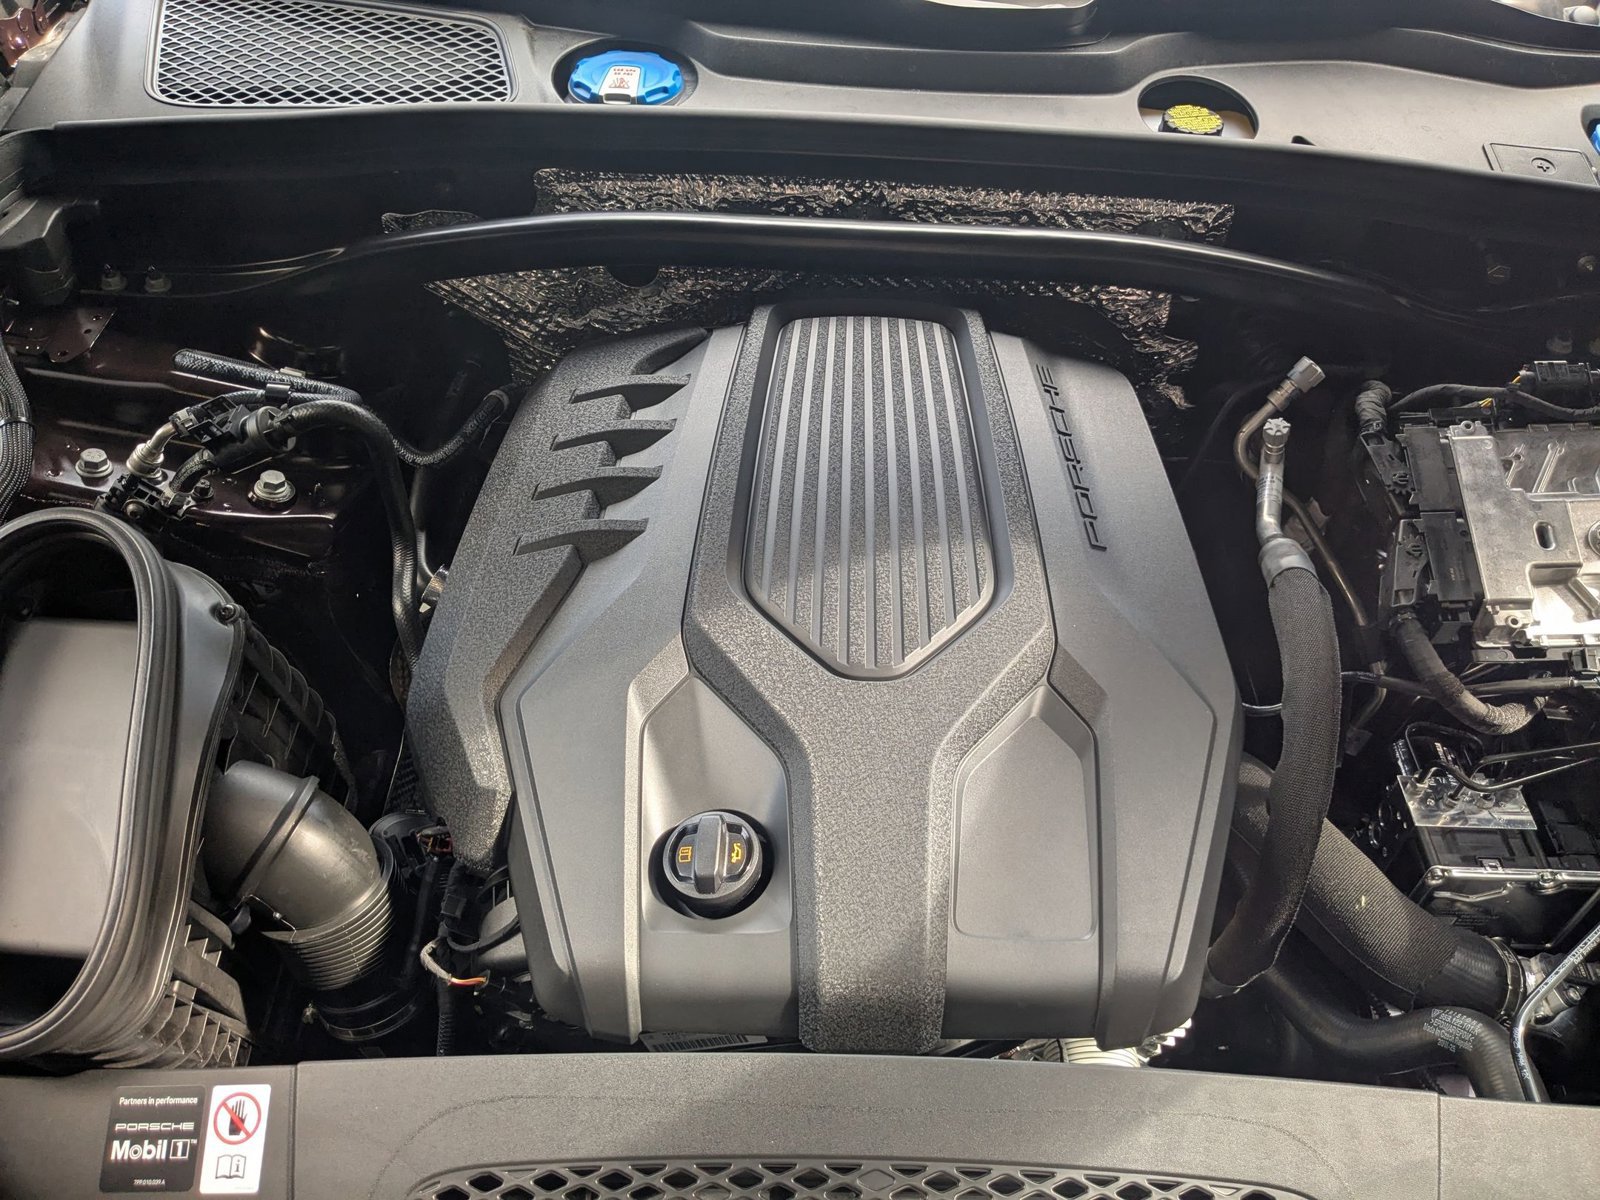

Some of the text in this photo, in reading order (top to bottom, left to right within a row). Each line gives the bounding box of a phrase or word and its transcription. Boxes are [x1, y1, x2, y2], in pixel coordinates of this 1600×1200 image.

[1036, 364, 1107, 552] PORSCHE
[119, 1096, 198, 1107] Partners in performance
[115, 1122, 195, 1131] PORSCHE
[110, 1139, 168, 1160] Mobil
